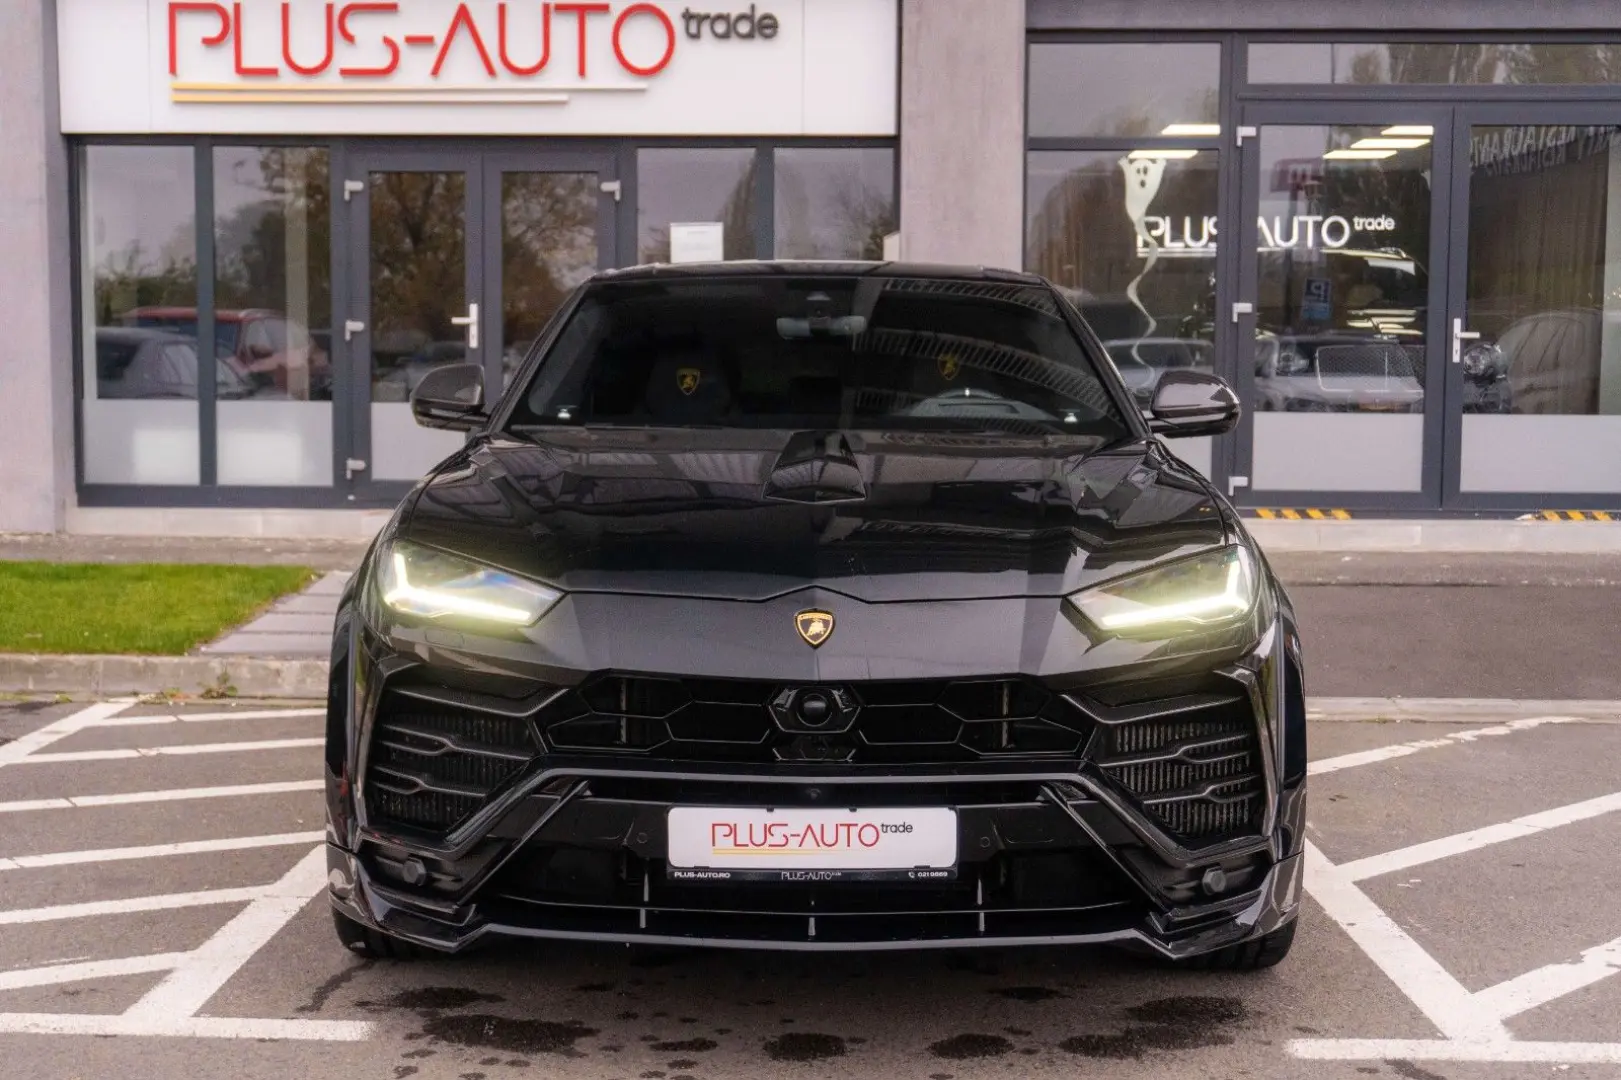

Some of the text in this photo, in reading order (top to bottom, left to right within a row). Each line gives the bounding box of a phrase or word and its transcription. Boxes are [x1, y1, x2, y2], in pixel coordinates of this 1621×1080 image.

[168, 2, 779, 77] PLUS-AUTO trade
[1353, 215, 1396, 231] trade
[711, 821, 914, 847] PLUS-AUTO trade
